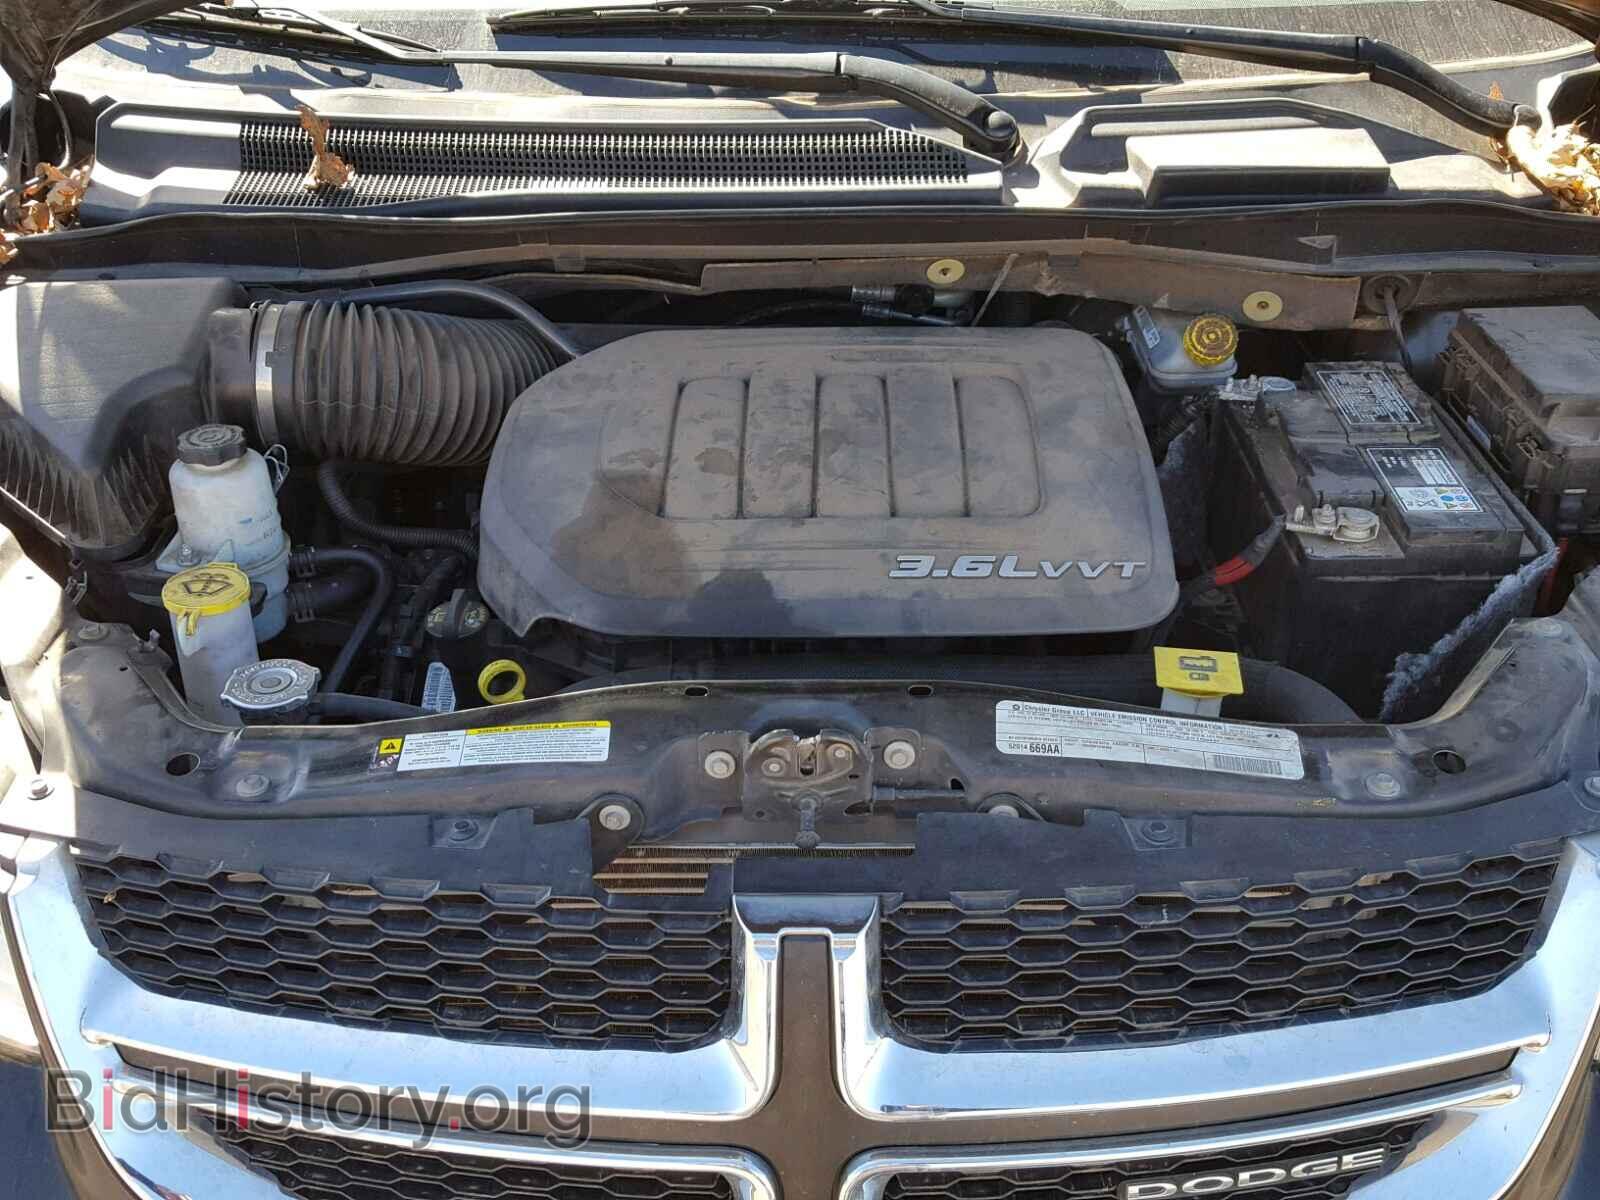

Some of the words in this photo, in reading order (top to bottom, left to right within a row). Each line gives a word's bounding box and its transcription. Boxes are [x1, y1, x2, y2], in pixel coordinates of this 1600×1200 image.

[1090, 711, 1116, 720] VEHICLE
[1118, 713, 1147, 722] EMISSION
[1149, 716, 1177, 725] CONTROL
[1179, 719, 1222, 730] INFORMATION
[1126, 1147, 1386, 1200] DODGE
